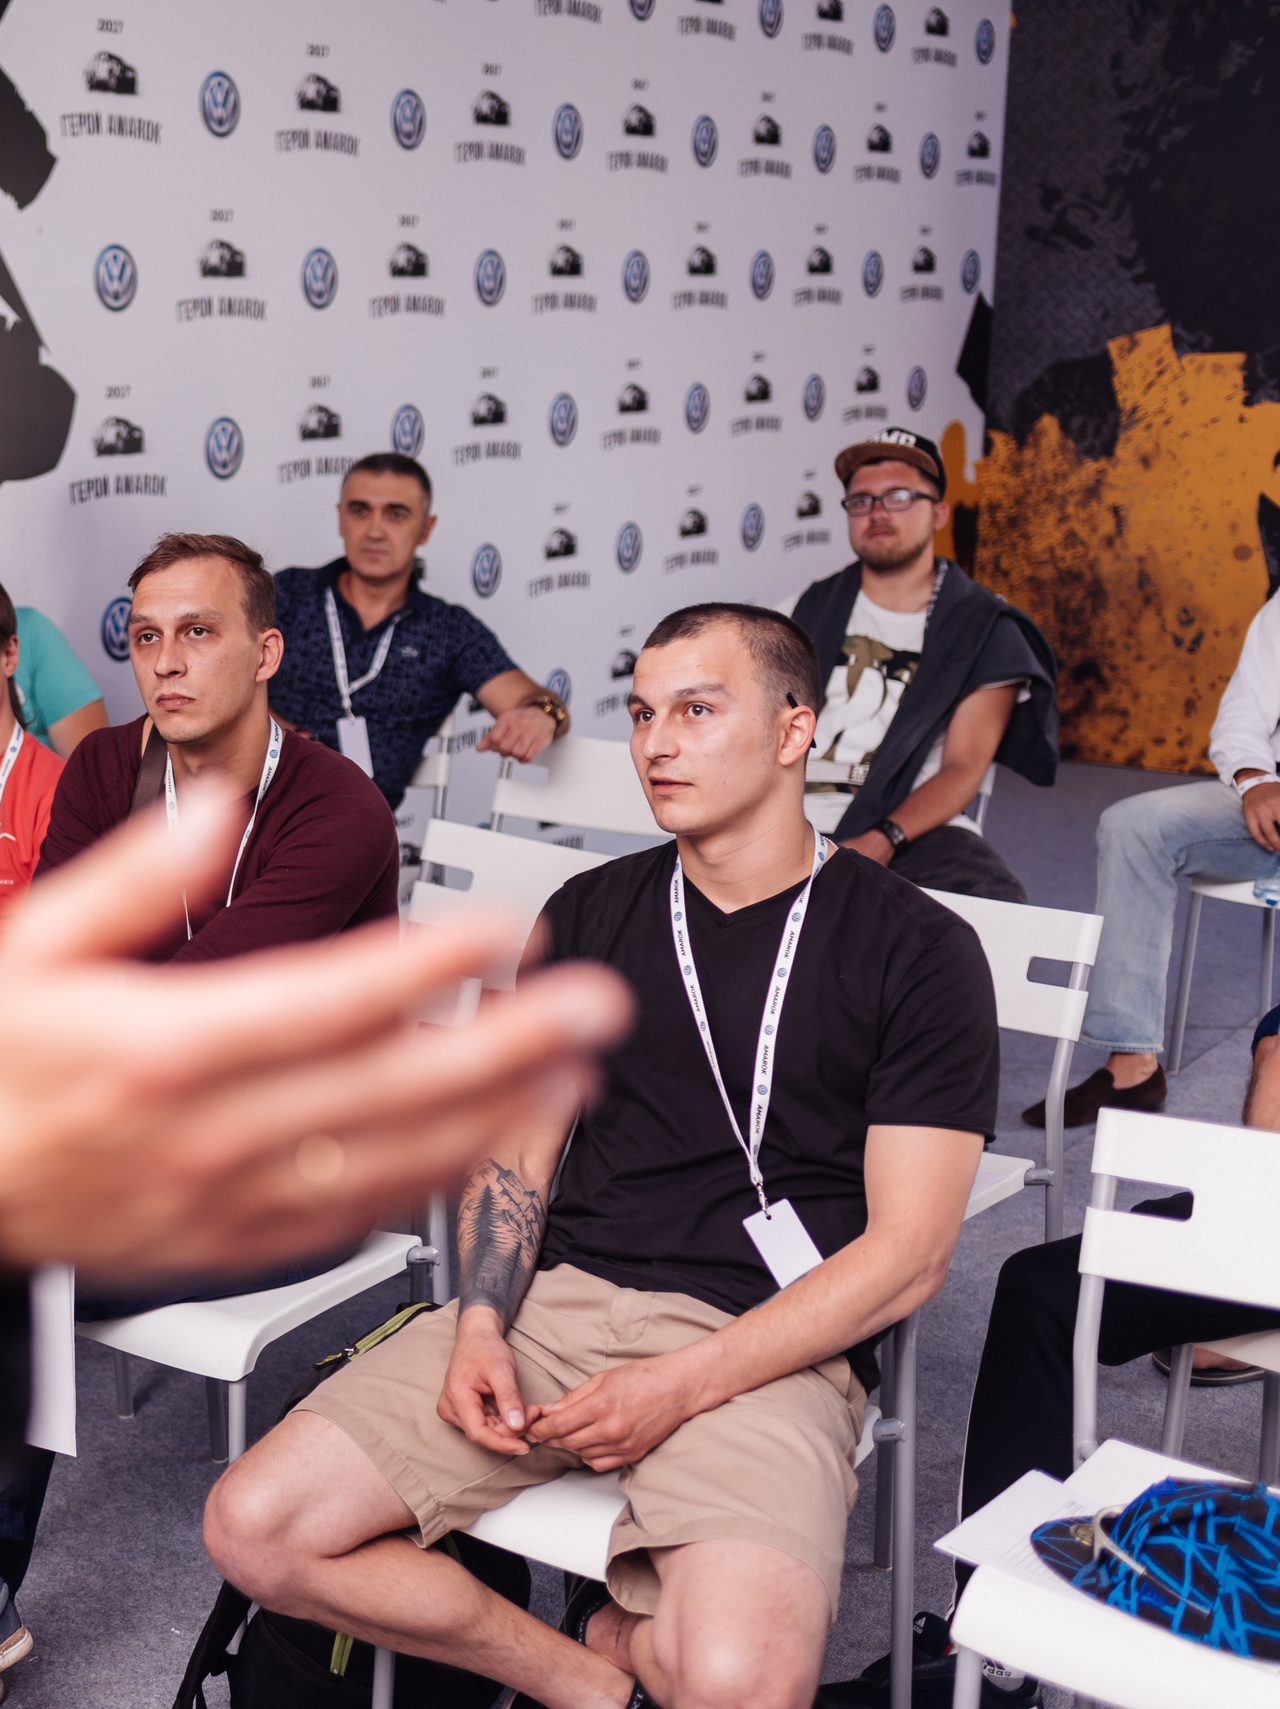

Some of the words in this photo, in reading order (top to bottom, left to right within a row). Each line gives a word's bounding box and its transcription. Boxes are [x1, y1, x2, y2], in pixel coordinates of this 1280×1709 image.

[97, 18, 124, 33] 2017
[107, 114, 162, 144] AMAROK
[314, 130, 361, 156] AMAROK
[218, 296, 267, 320] AMAROK
[105, 385, 131, 399] 2017
[316, 456, 355, 475] AMAR
[114, 474, 167, 496] AMAROK
[677, 929, 686, 956] AMAROK
[784, 930, 795, 959] AMAROK
[689, 984, 701, 1012] AMAROK
[770, 986, 781, 1016] AMAROK
[760, 1044, 770, 1075] AMAROK
[754, 1104, 763, 1135] AMAROK
